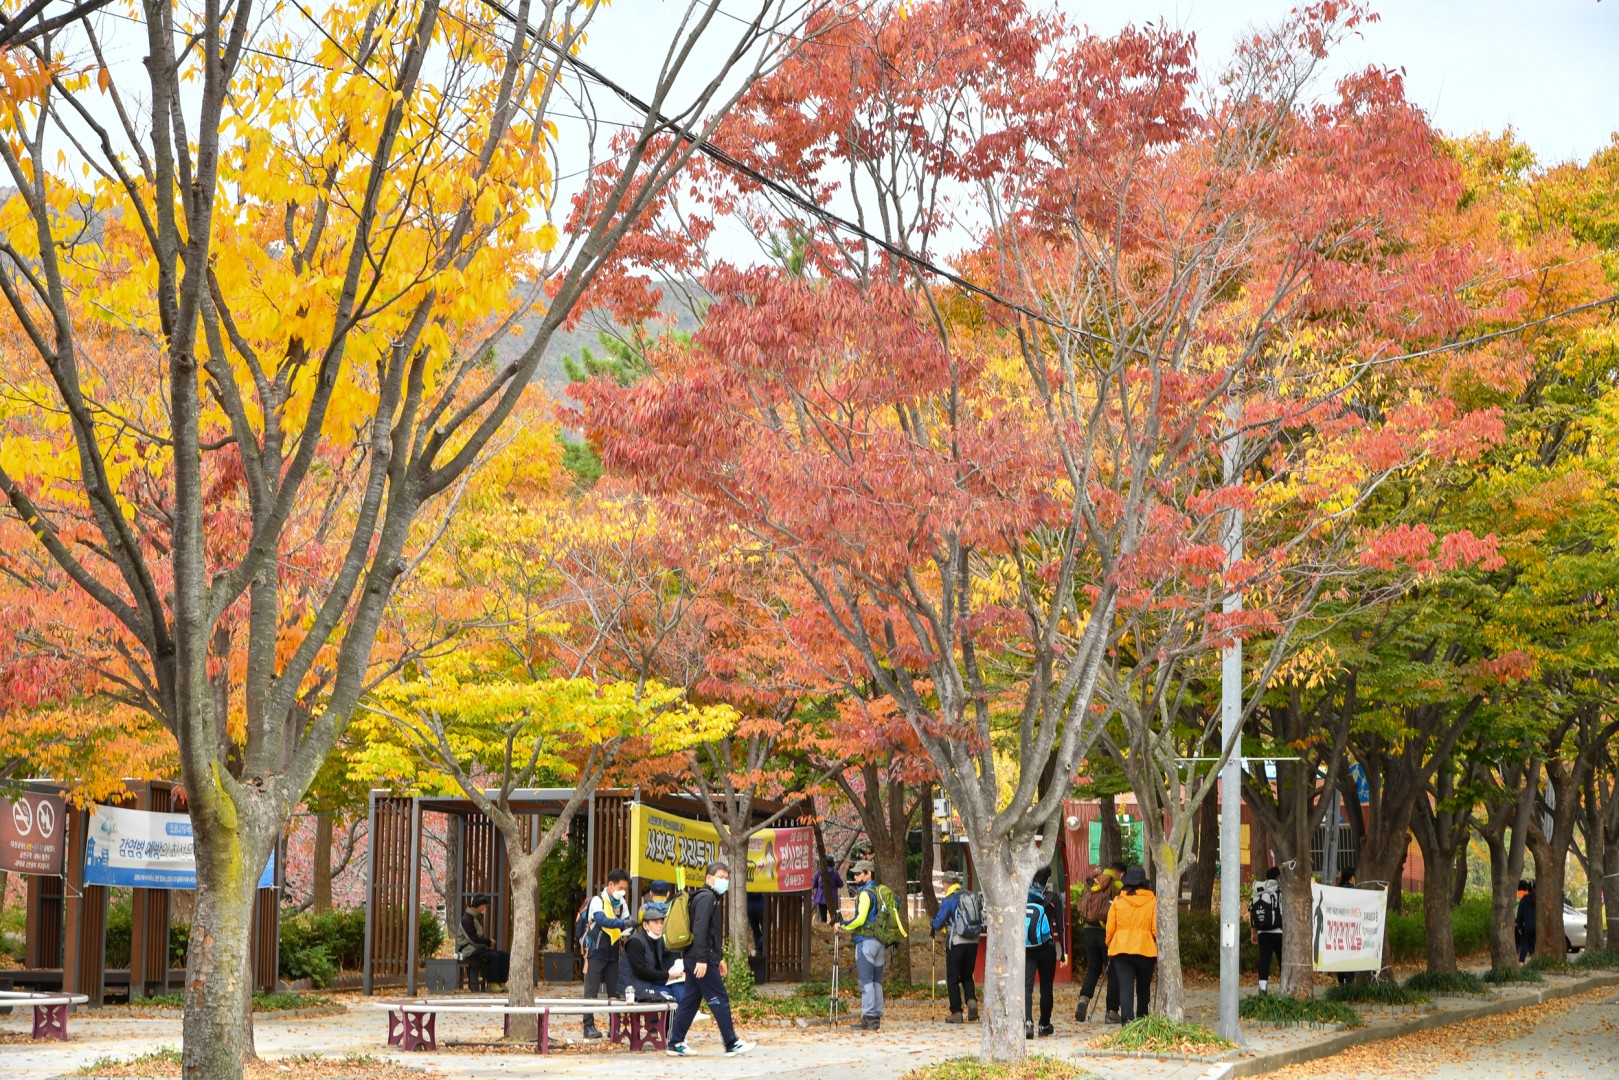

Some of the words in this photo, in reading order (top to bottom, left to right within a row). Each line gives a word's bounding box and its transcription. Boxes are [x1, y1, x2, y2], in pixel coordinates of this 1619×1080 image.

[120, 838, 145, 859] 감염병
[645, 827, 677, 867] 사회적
[677, 835, 715, 871] 거리두기
[779, 843, 809, 871] 잠시멈춤
[685, 870, 697, 881] Social
